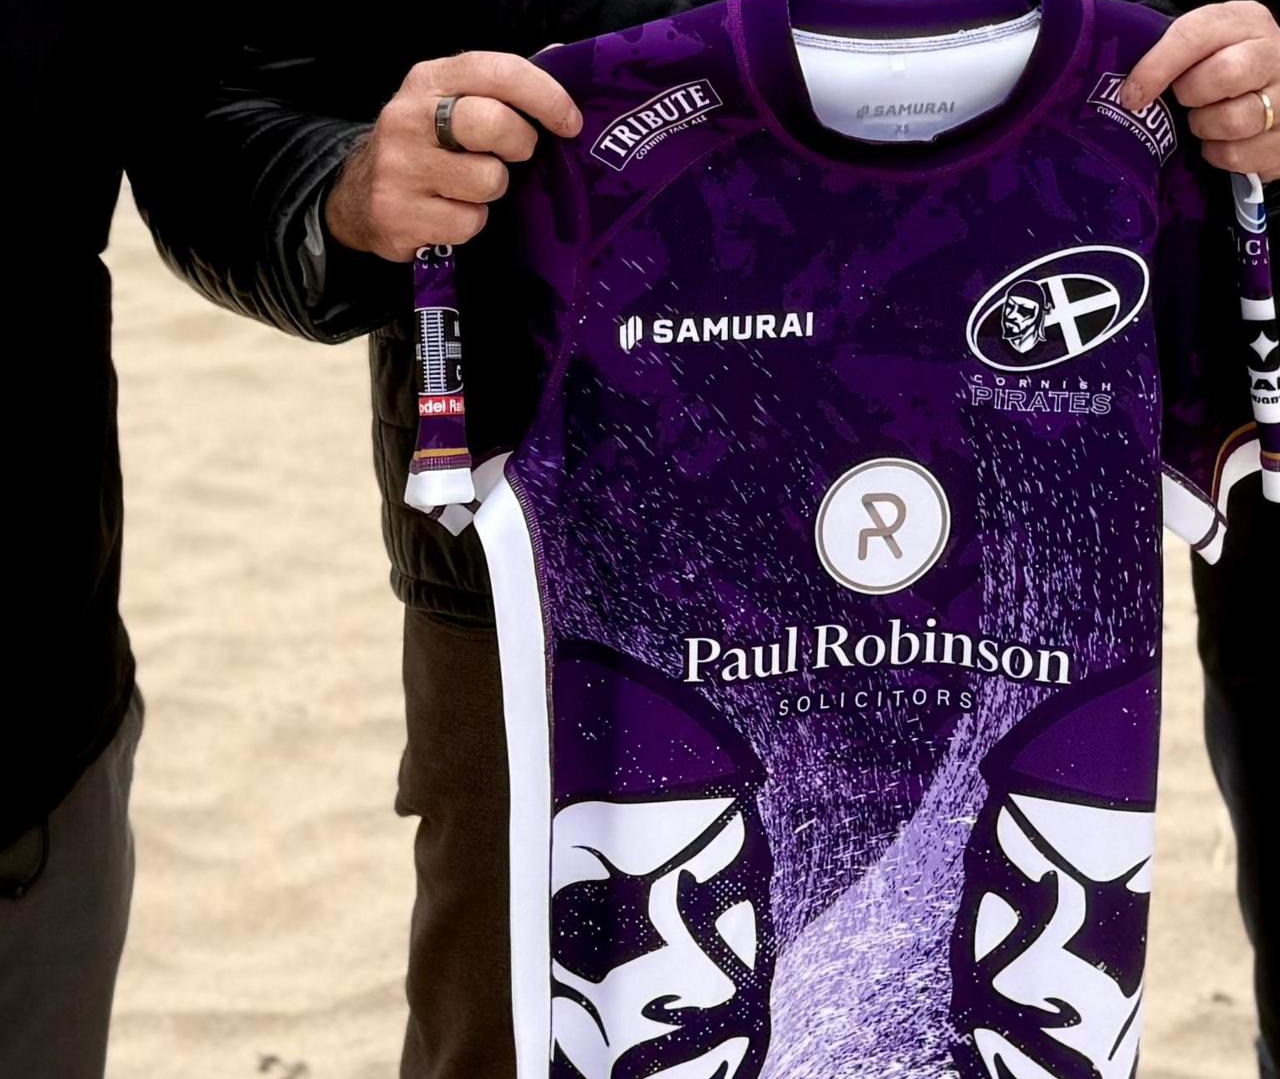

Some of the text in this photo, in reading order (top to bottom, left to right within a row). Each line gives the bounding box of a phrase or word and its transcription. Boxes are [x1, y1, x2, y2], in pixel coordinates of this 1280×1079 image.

[599, 84, 711, 158] TRIBUTE
[874, 101, 955, 117] SAMURAI
[652, 311, 814, 344] SAMURAI
[972, 374, 1112, 392] CORNISH
[971, 385, 1112, 415] PIRATES
[683, 618, 1072, 686] Paul Robinson
[777, 687, 974, 717] SOLICITORS
